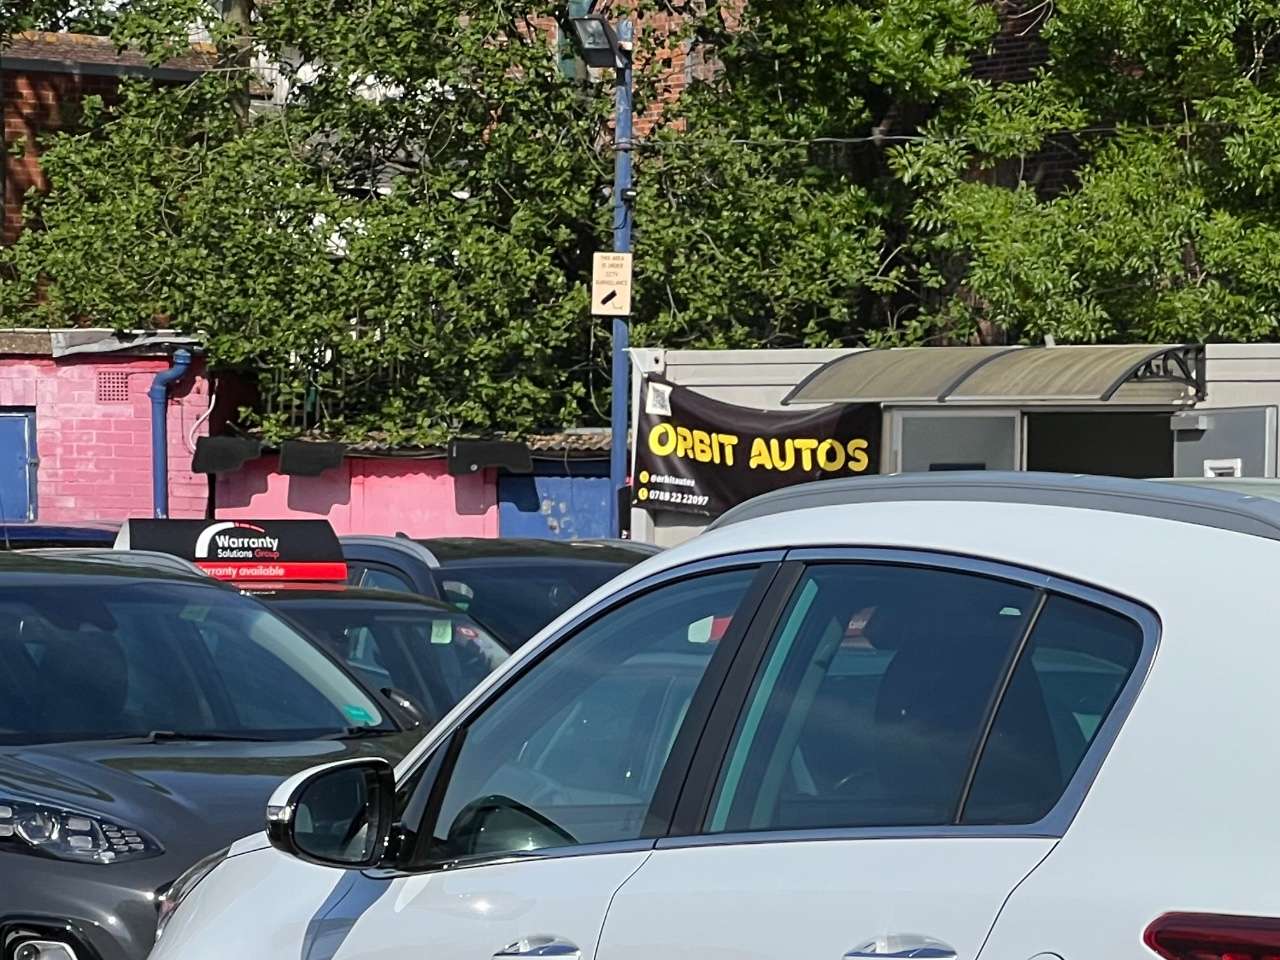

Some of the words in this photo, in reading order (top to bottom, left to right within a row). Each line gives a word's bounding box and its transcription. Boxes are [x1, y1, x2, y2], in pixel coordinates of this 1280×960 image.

[648, 422, 739, 467] ORBIT
[749, 437, 869, 472] AUTOS
[215, 534, 279, 551] Warranty
[217, 548, 253, 558] Solutions
[254, 549, 280, 560] Group
[238, 565, 284, 576] available
